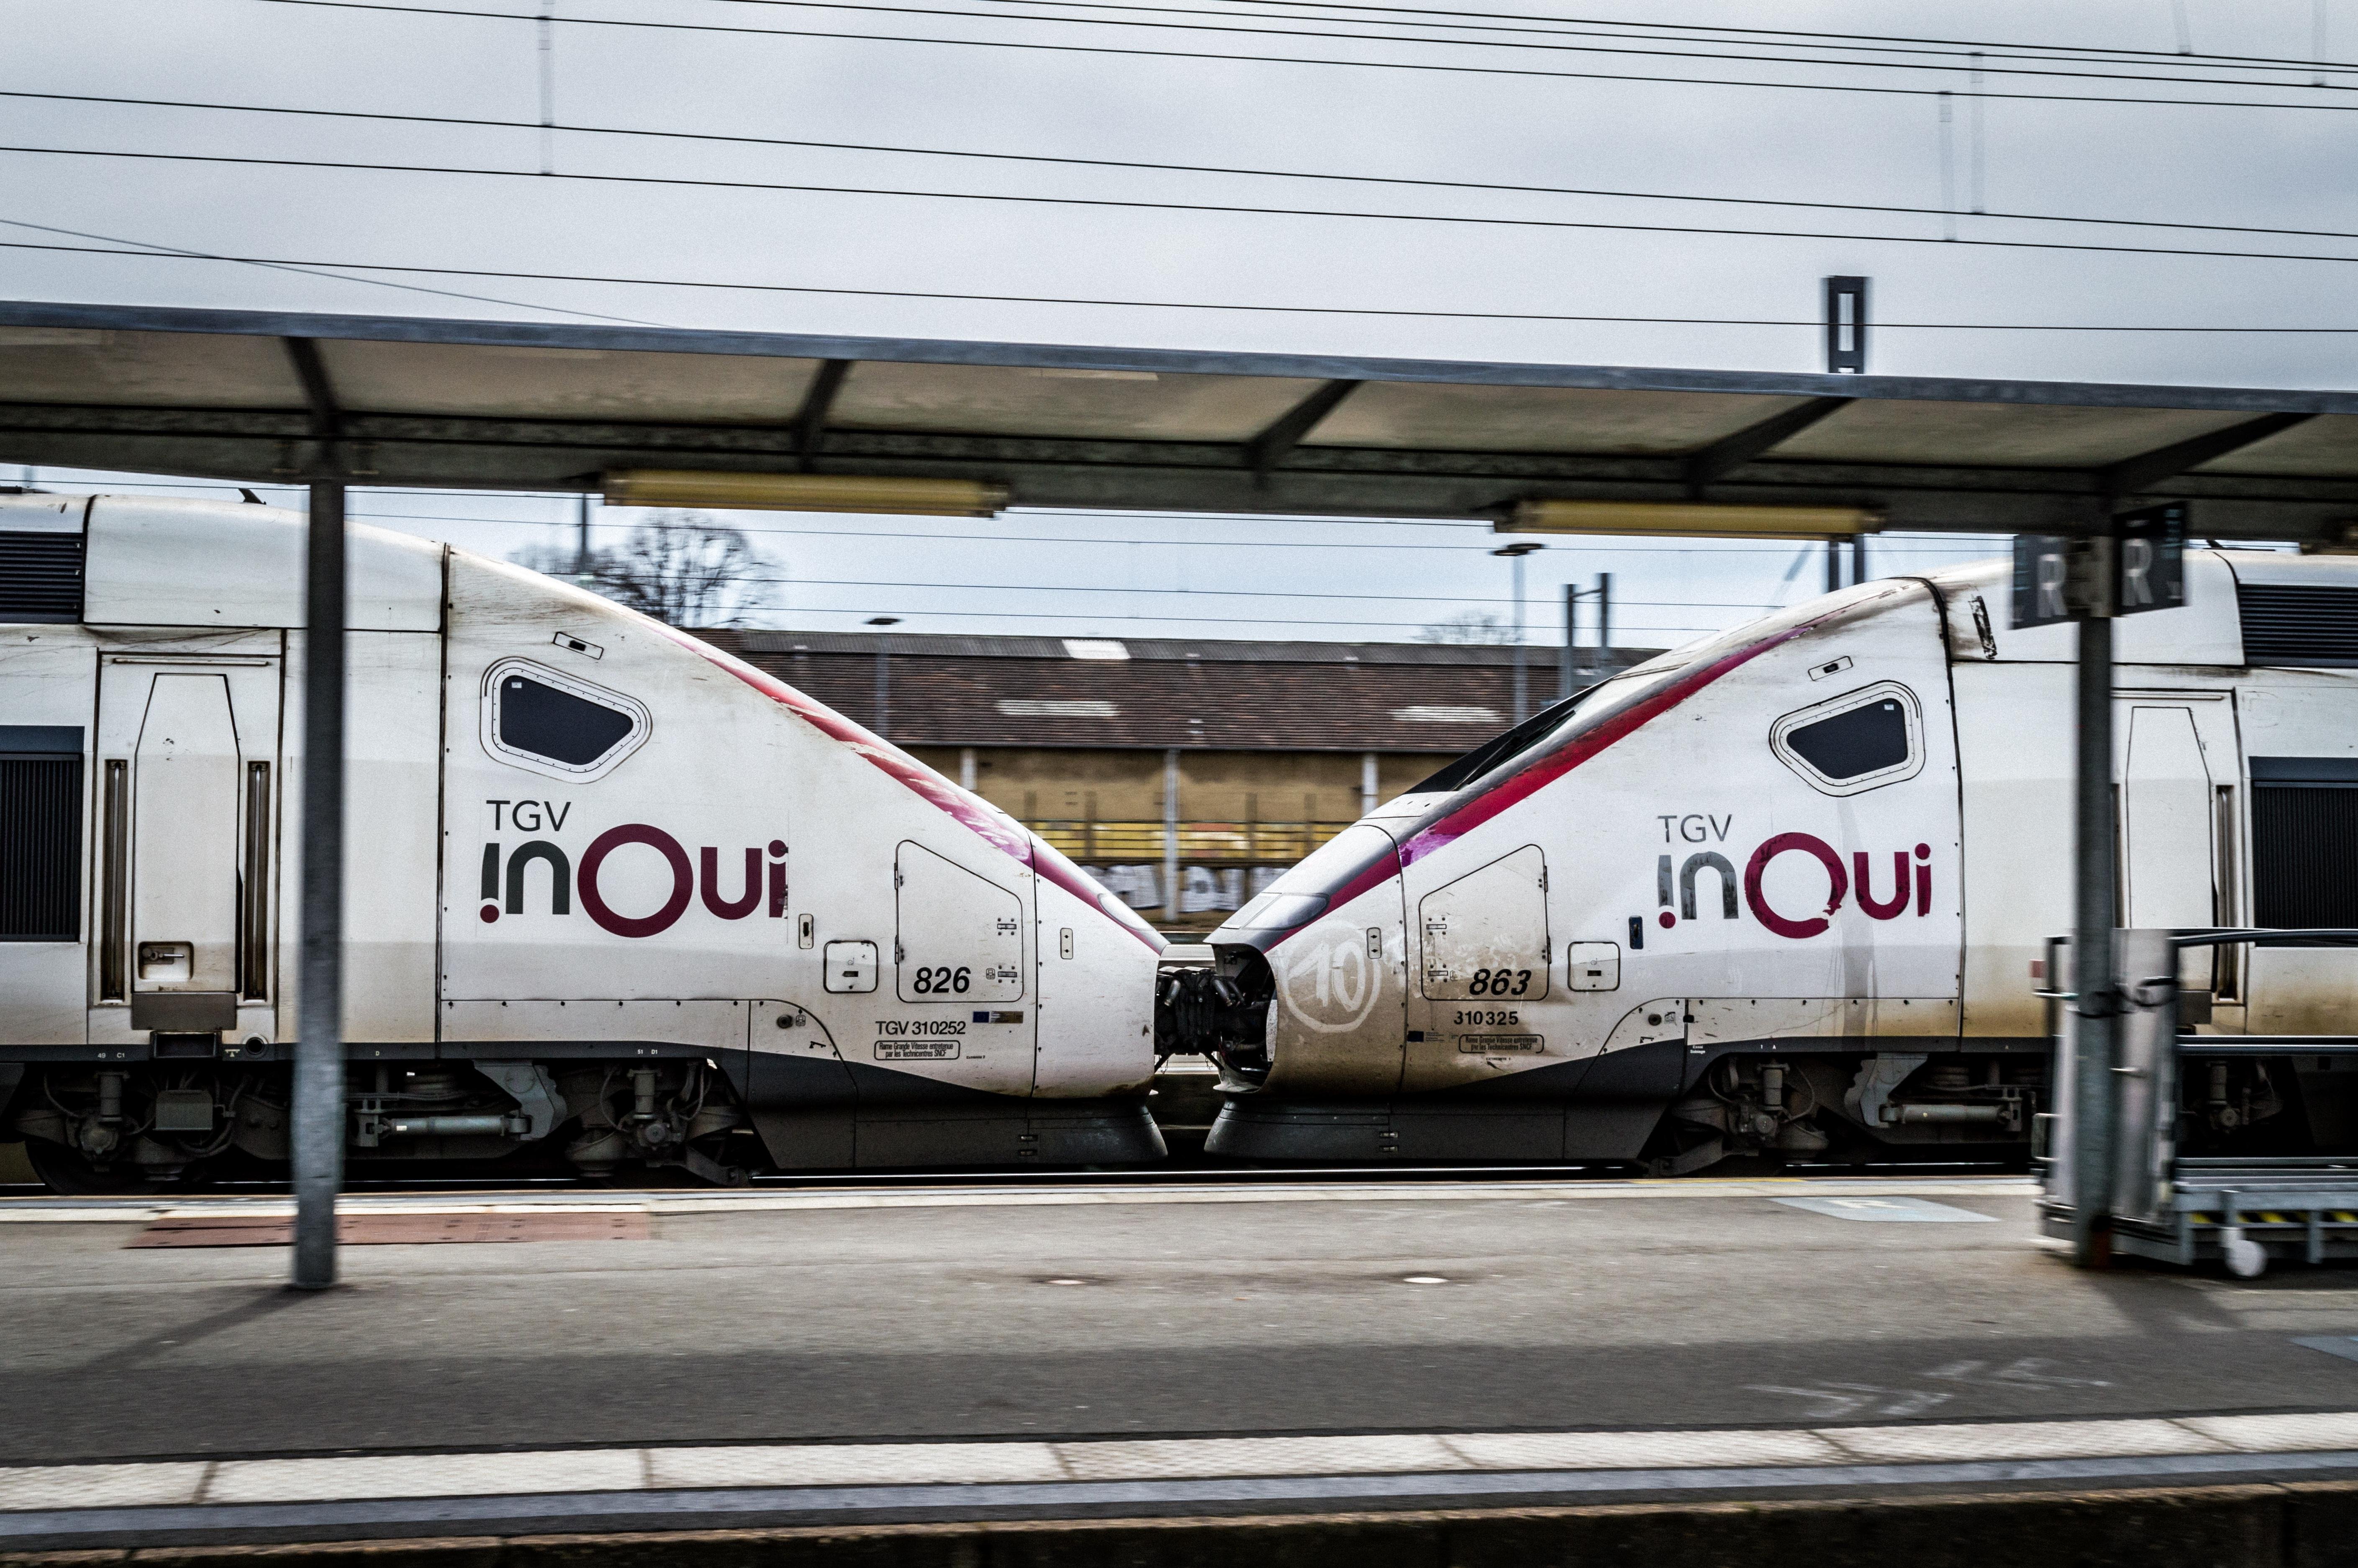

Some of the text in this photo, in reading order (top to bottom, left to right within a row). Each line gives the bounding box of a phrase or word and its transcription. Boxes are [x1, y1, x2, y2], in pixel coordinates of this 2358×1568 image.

[2037, 553, 2068, 618] R
[2122, 538, 2154, 606] R
[486, 800, 571, 832] TGV
[1658, 814, 1732, 843] TGV
[913, 966, 971, 994] 826
[1469, 968, 1532, 996] 863
[875, 1021, 966, 1035] TGV 310252
[1453, 1011, 1519, 1025] 310325
